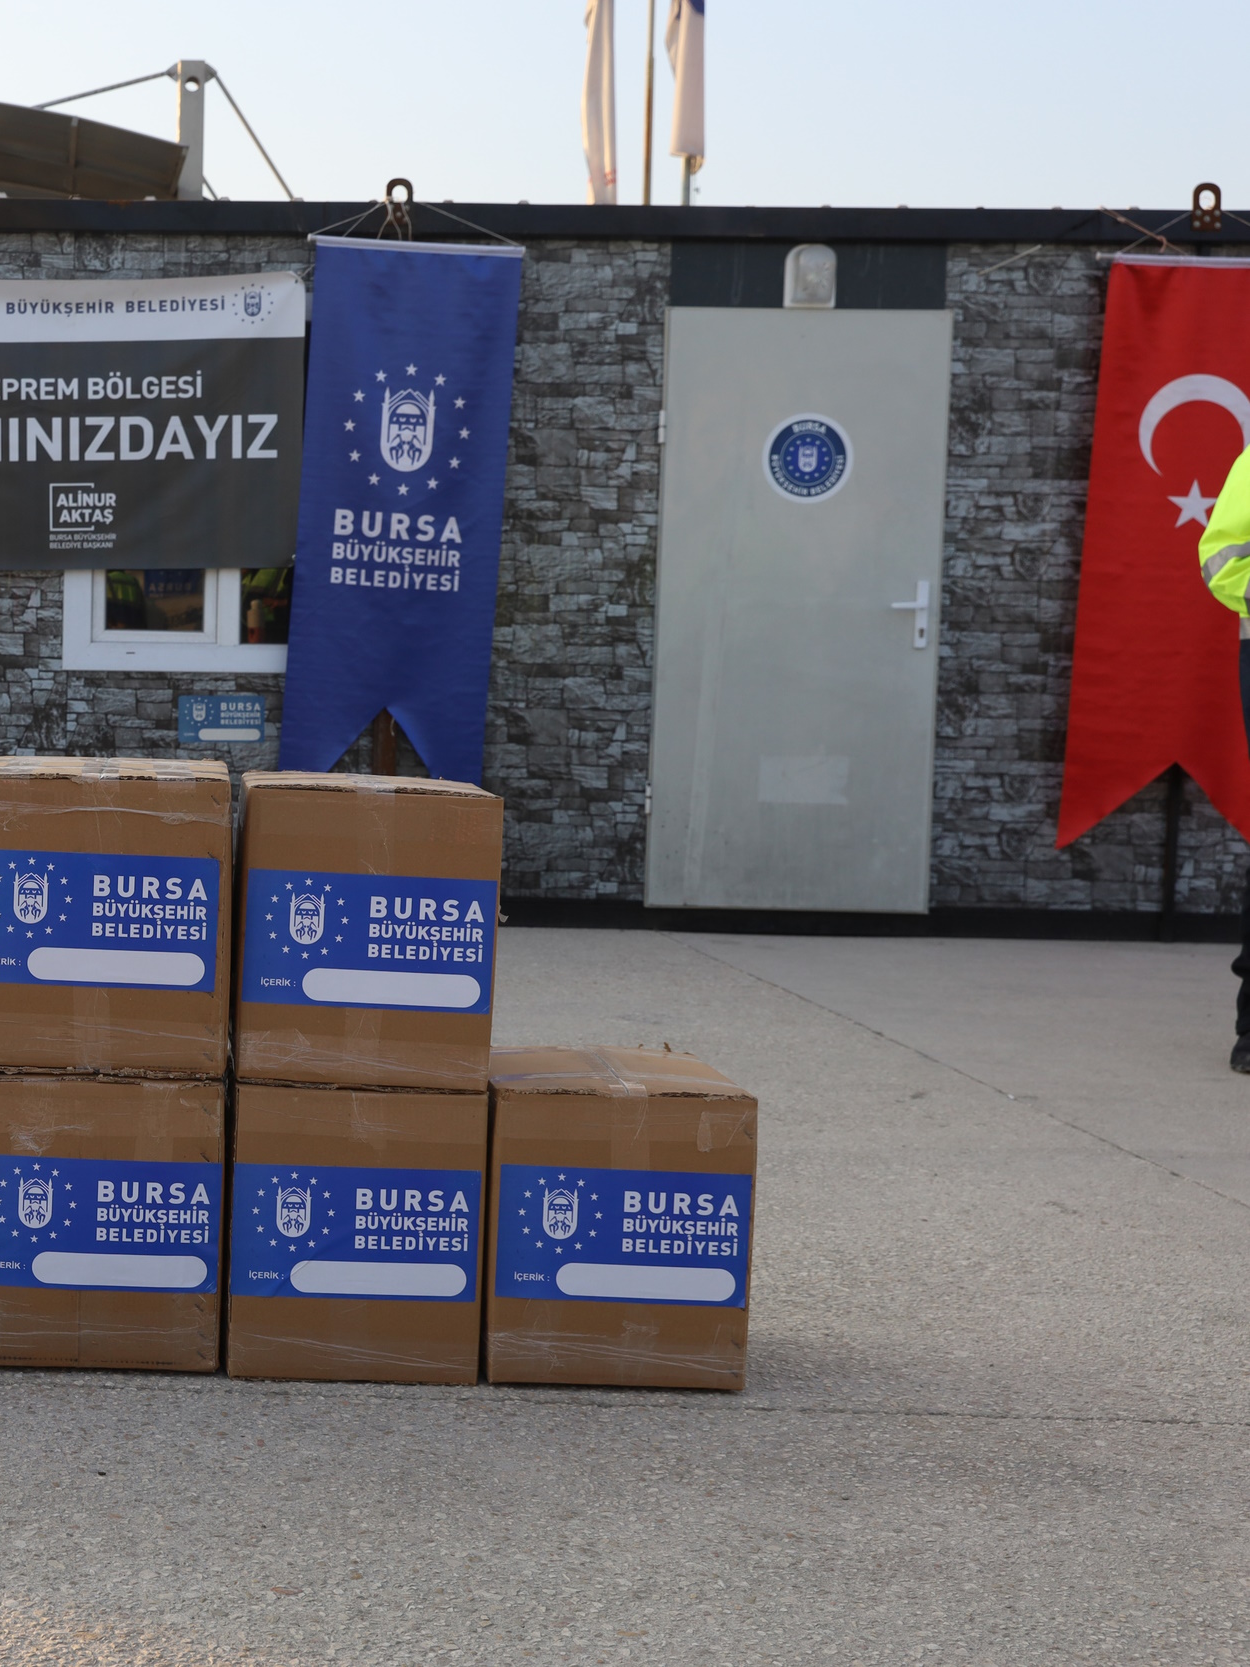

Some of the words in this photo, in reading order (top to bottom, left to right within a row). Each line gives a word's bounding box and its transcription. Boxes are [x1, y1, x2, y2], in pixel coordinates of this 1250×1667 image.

[5, 299, 115, 317] BÜYÜKŞEHİR
[125, 296, 226, 313] BELEDİYESİ
[87, 370, 202, 400] BÖLGESİ
[791, 421, 827, 434] BURSA
[56, 490, 116, 507] ALİNUR
[59, 508, 114, 525] AKTAŞ
[334, 508, 462, 543] BURSA
[73, 532, 117, 541] BÜYÜKŞEHİR
[83, 541, 114, 549] BAŞKANI
[332, 539, 460, 569] BÜYÜKŞEHİR
[330, 565, 459, 592] BELEDİYESİ
[220, 702, 261, 711] BURSA
[93, 875, 207, 900] BURSA
[93, 899, 206, 921] BÜYÜKŞEHİR
[370, 896, 484, 922] BURSA
[92, 920, 206, 940] BELEDİYESİ
[369, 921, 483, 943] BÜYÜKŞEHİR
[368, 941, 483, 962] BELEDİYESİ
[261, 977, 291, 987] İÇERİK
[97, 1180, 210, 1204] BURSA
[356, 1188, 469, 1212] BURSA
[624, 1191, 739, 1216] BURSA
[97, 1205, 209, 1225] BÜYÜKŞEHİR
[355, 1212, 468, 1233] BÜYÜKŞEHİR
[96, 1224, 209, 1243] BELEDİYESİ
[623, 1215, 738, 1237] BÜYÜKŞEHİR
[354, 1231, 468, 1251] BELEDİYESİ
[622, 1235, 737, 1256] BELEDİYESİ
[249, 1270, 279, 1280] İÇERİK
[514, 1272, 544, 1282] İÇERİK
